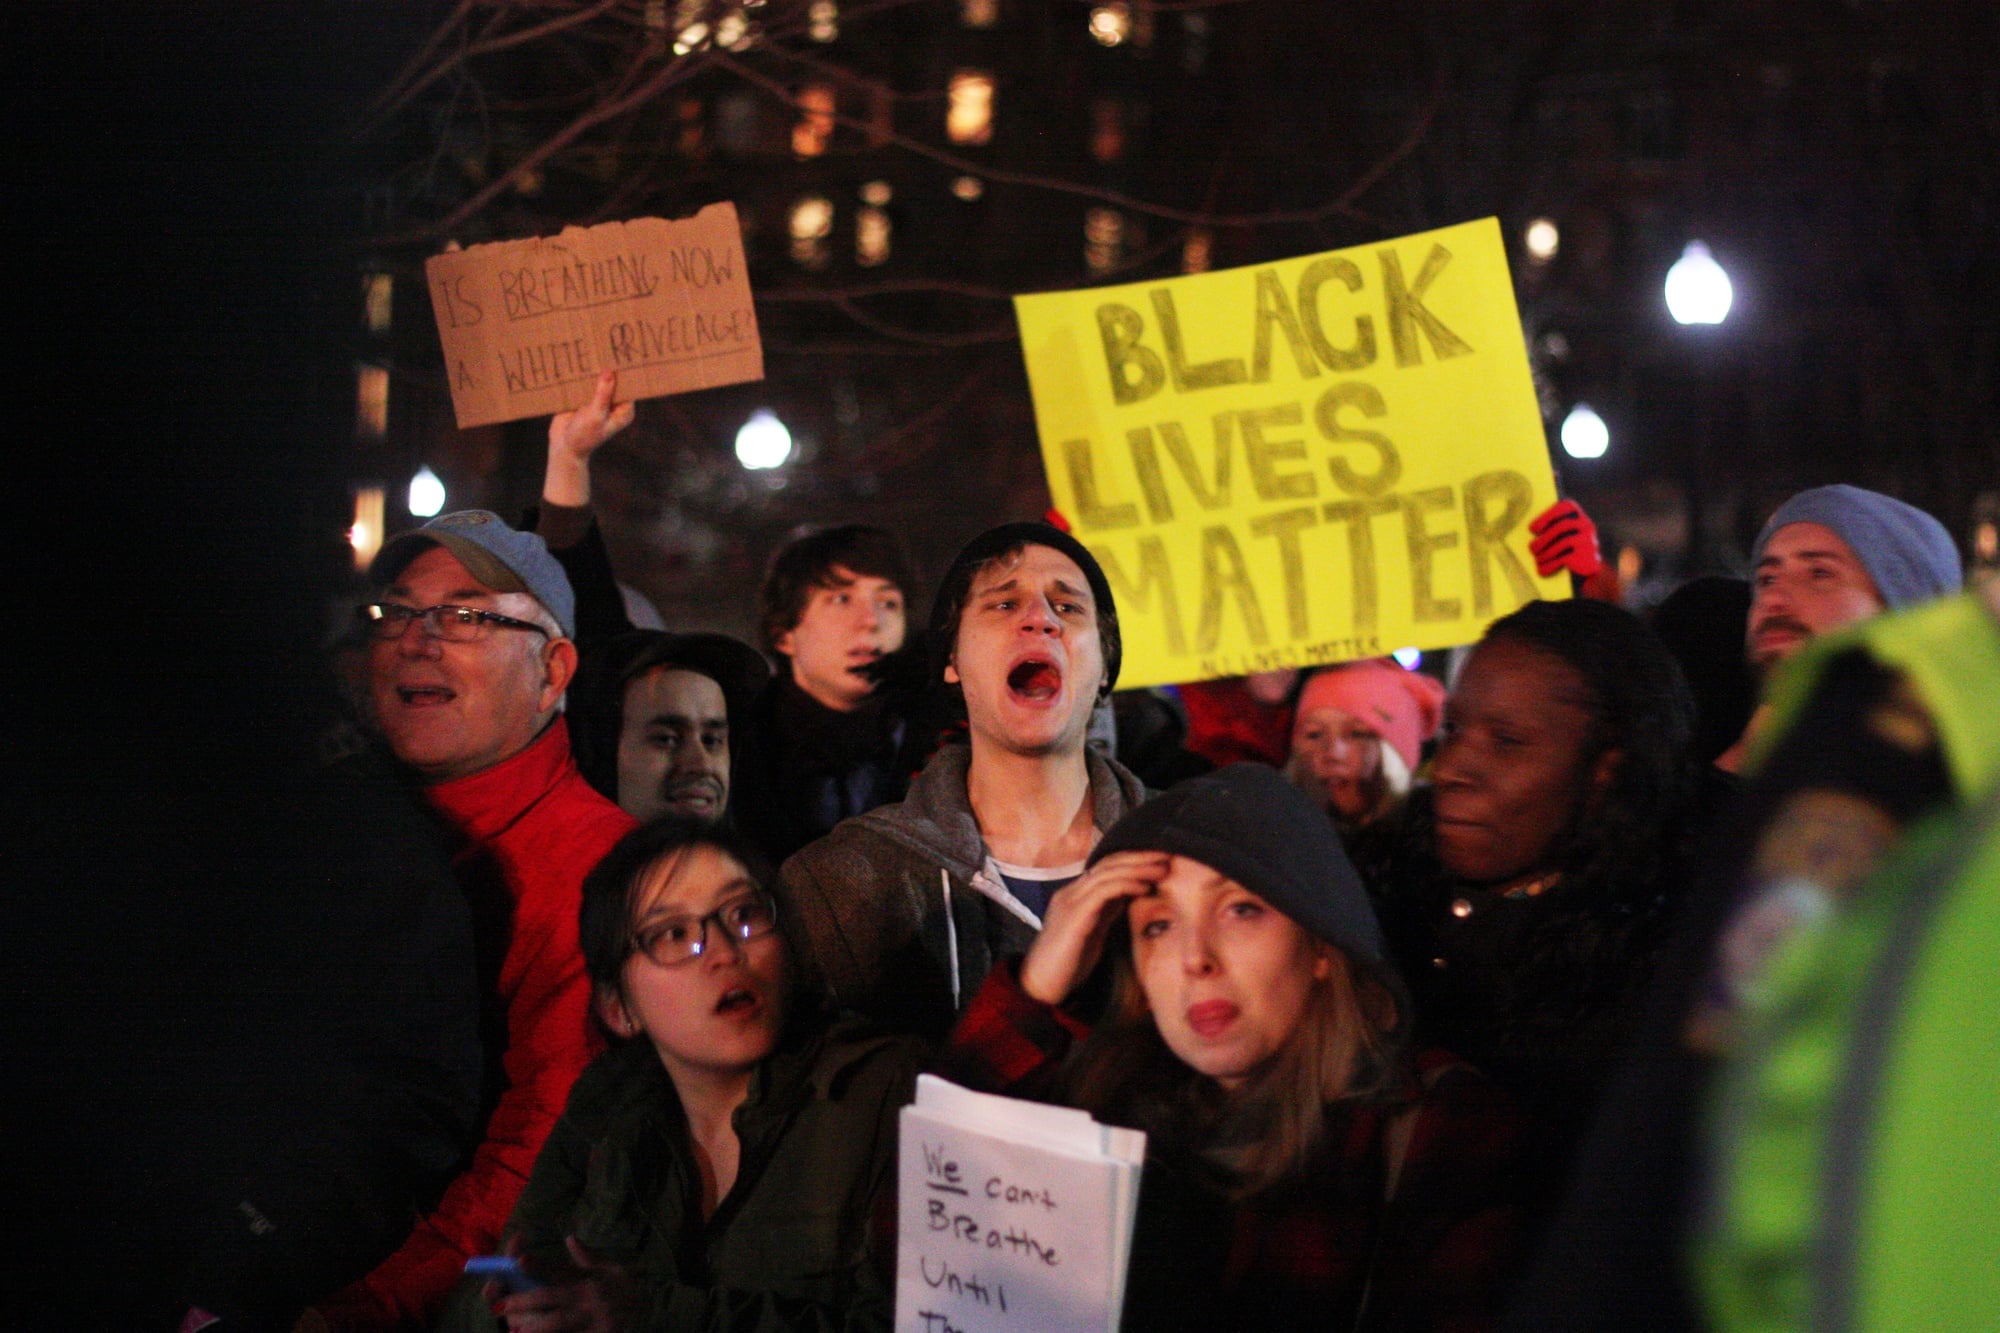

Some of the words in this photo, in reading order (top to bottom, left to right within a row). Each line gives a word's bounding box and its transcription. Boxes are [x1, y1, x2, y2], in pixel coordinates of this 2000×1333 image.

[441, 275, 483, 328] IS
[499, 254, 660, 319] BREATHING
[670, 246, 732, 290] NOW
[1095, 242, 1476, 406] BLACK
[457, 358, 475, 391] A
[499, 338, 592, 393] WHITE
[1061, 380, 1403, 533] LIVES
[1089, 469, 1542, 661] MATTER
[1305, 637, 1380, 664] MATTER
[922, 1143, 962, 1183] We
[927, 1199, 1060, 1266] Breathe
[920, 1257, 1007, 1313] Until
